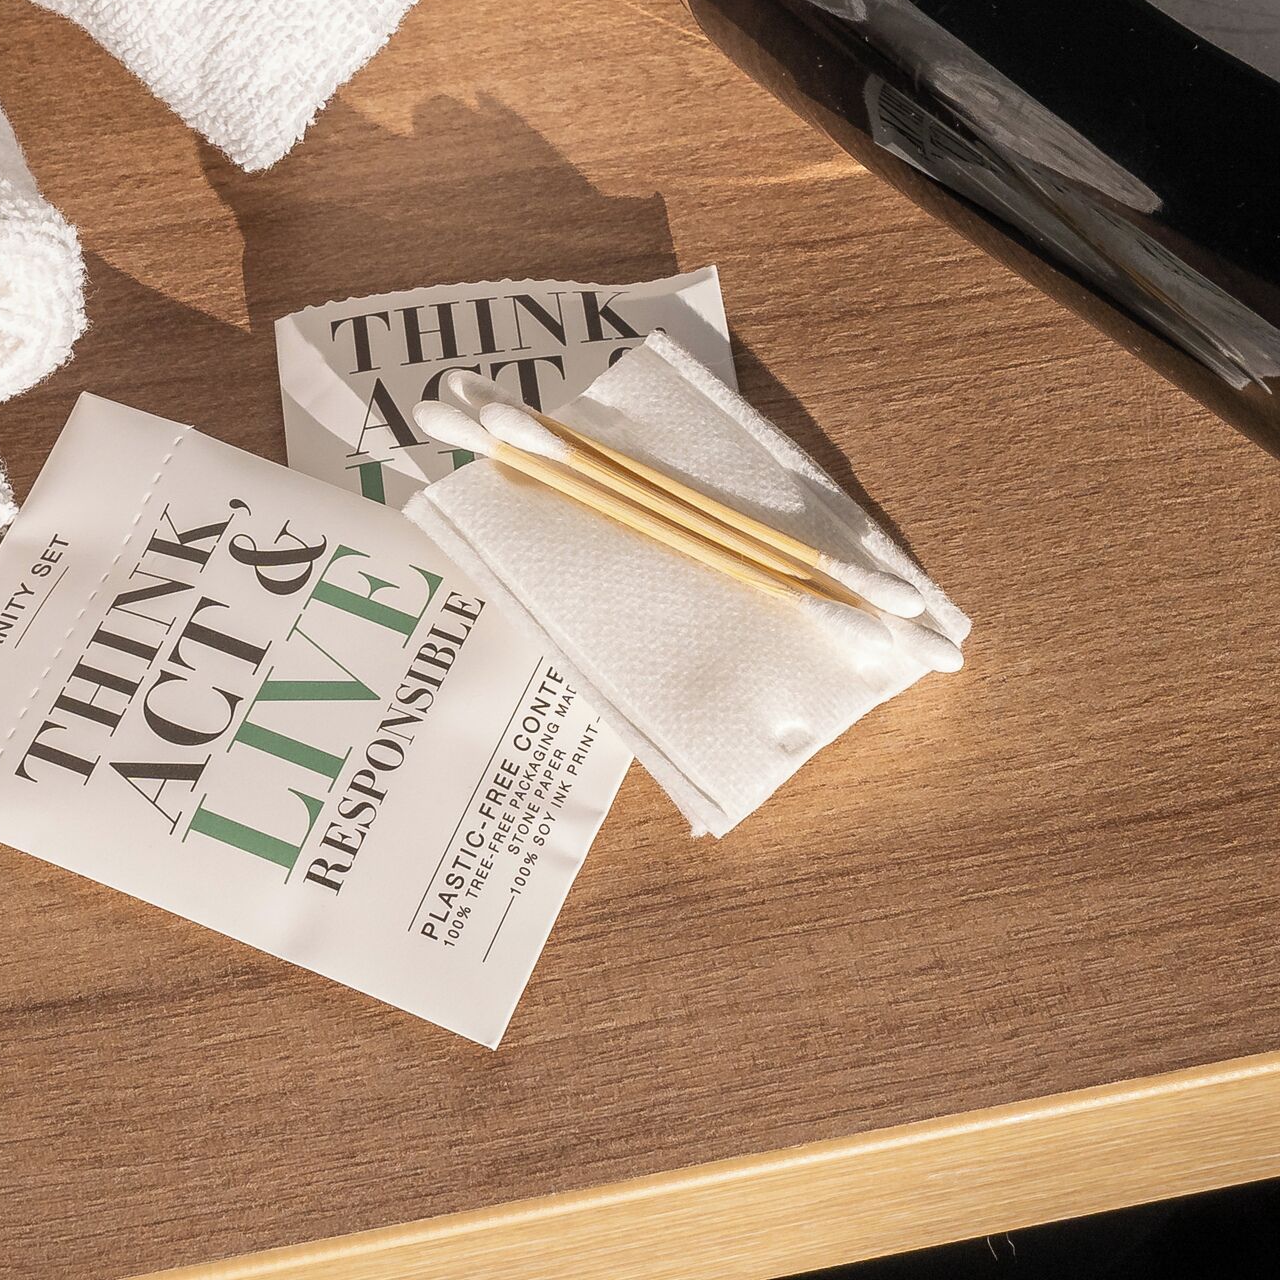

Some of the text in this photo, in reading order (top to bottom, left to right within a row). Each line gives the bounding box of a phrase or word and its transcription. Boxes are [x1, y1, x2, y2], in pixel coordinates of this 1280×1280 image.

[330, 291, 666, 374] THINK
[31, 533, 69, 577] SET
[109, 520, 327, 835] ACT &
[181, 544, 444, 884] LIVE
[303, 591, 486, 896] RESPONSIBLE
[421, 759, 520, 940] PLASTIC-FREE
[443, 905, 471, 948] 100%
[465, 812, 512, 900] TREE-FREE
[509, 722, 560, 810] PACKAGING
[507, 749, 567, 855] STONE PAPER
[510, 723, 598, 896] 100% SOY INK PRINT
